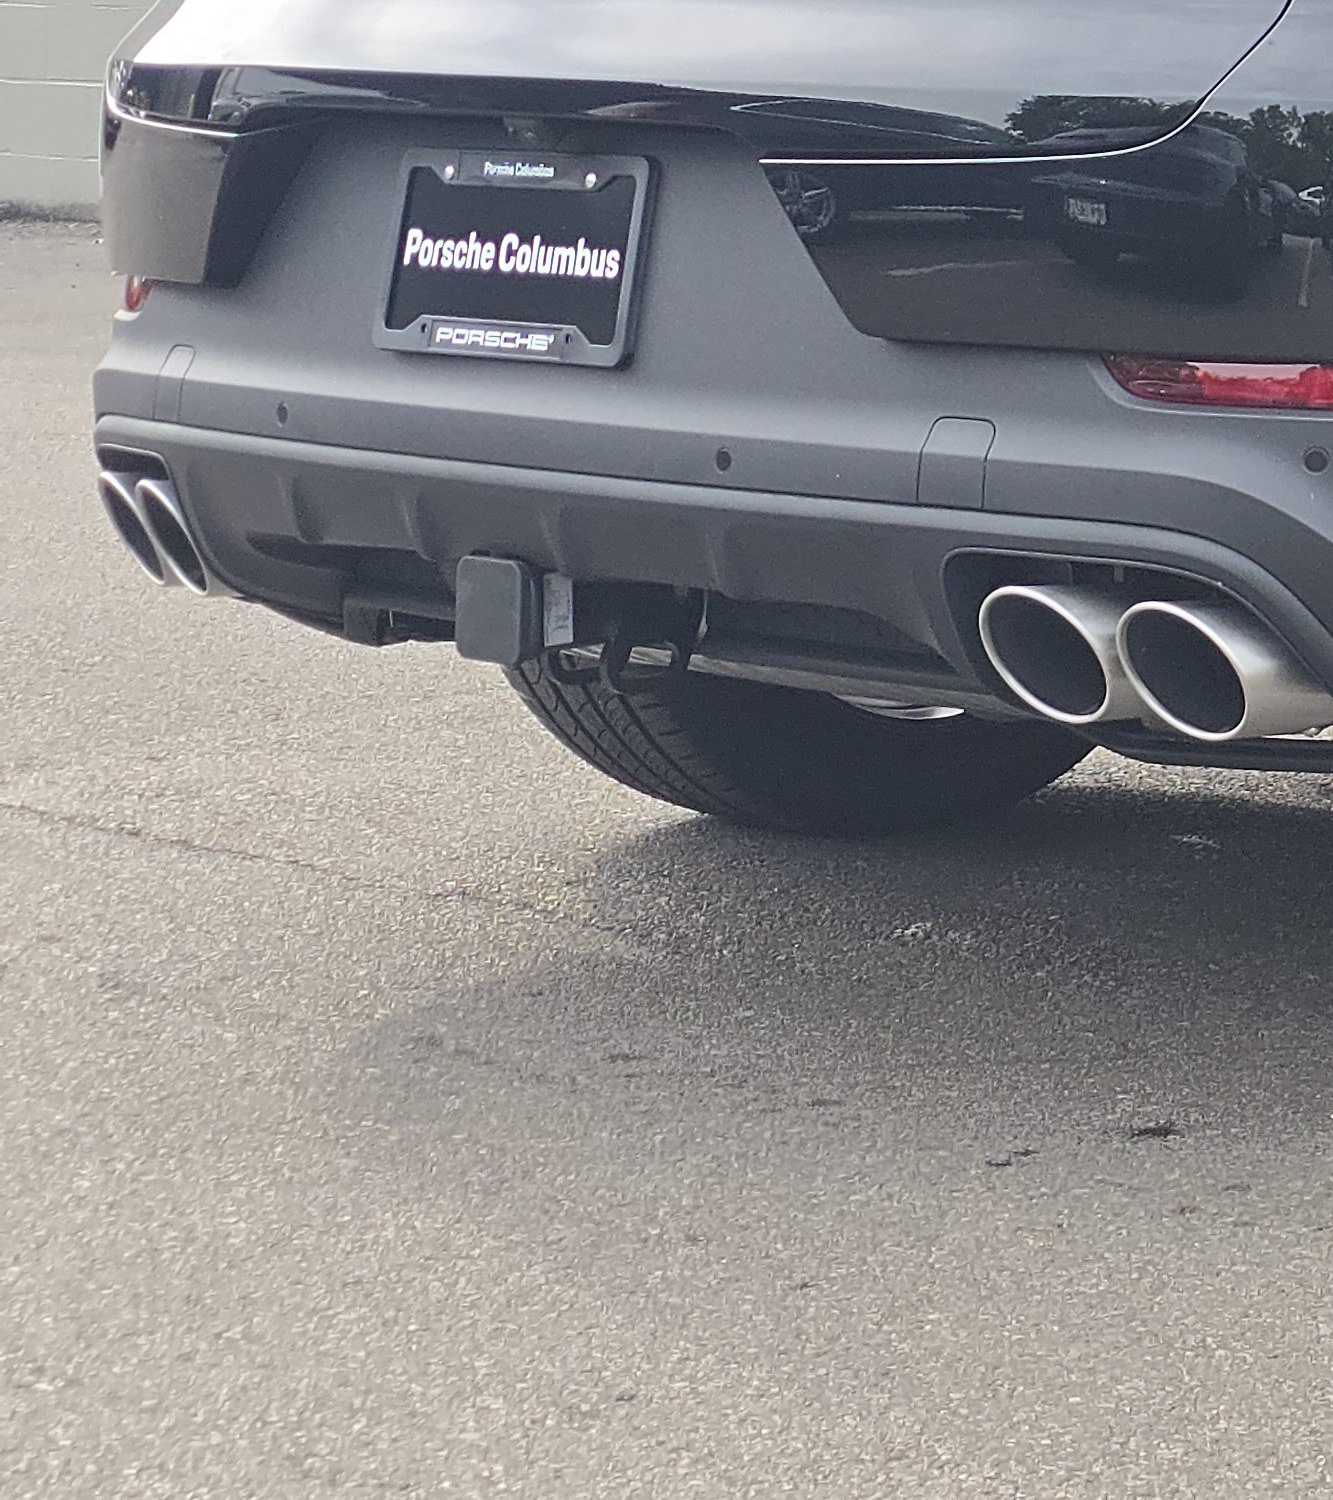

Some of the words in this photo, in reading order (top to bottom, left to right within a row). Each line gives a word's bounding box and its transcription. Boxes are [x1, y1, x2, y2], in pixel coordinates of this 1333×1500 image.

[403, 228, 496, 270] Porsche
[498, 233, 620, 279] Columbus
[436, 327, 550, 351] PORSCHE
